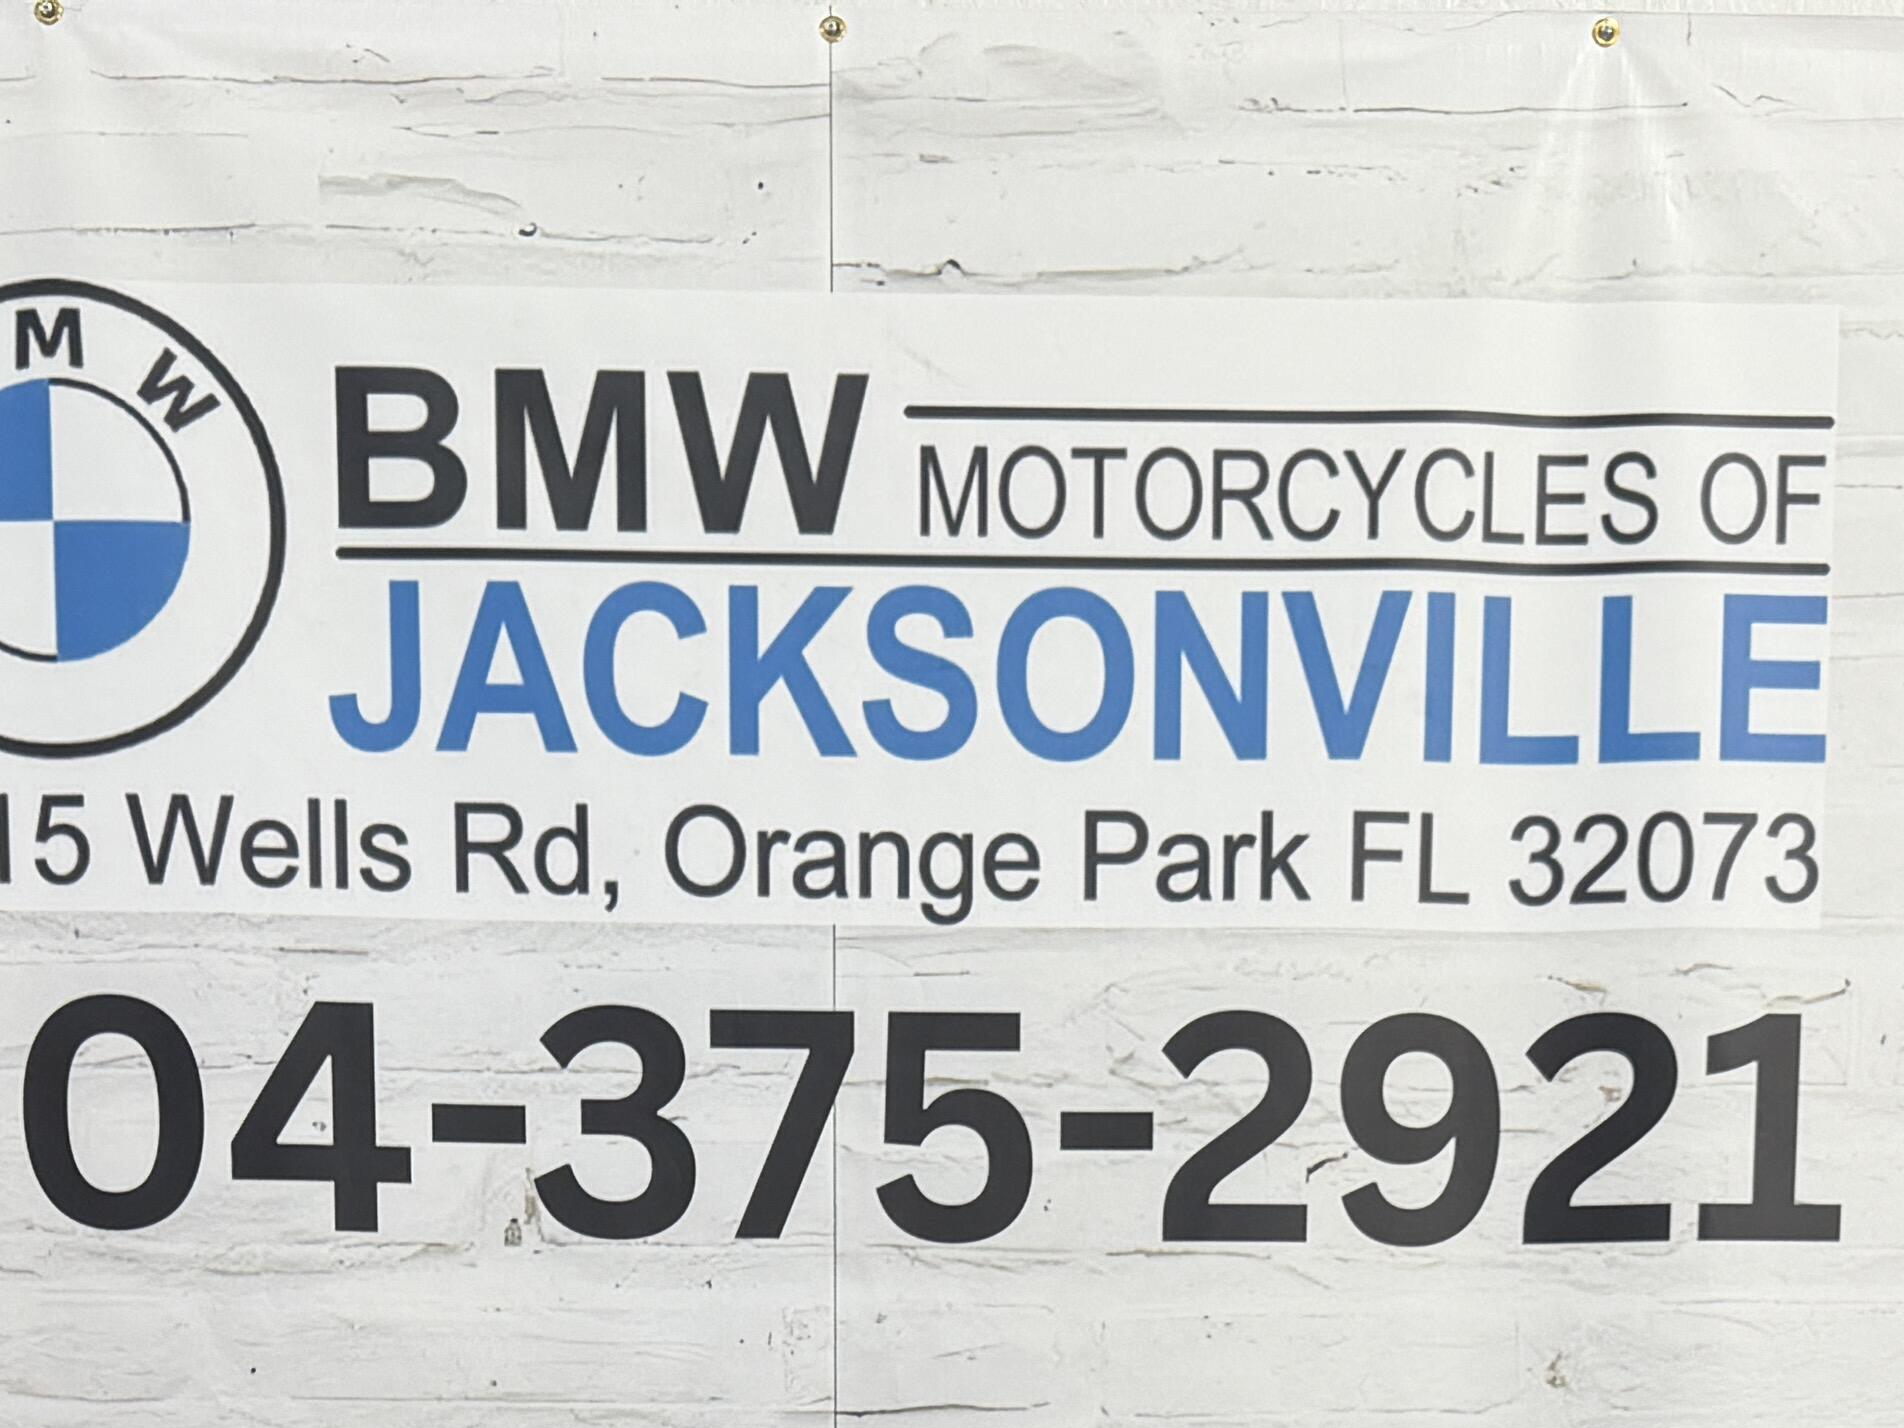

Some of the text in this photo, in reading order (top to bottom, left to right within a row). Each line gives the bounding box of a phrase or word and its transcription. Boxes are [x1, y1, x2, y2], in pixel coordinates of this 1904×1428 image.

[334, 365, 1827, 547] BMW MOTORCYCLES OF
[328, 579, 1829, 766] JACKSONVILLE
[125, 791, 414, 892] Wells
[454, 801, 620, 912] Rd,
[663, 803, 1042, 926] Orange
[1082, 808, 1313, 905] Park
[1350, 811, 1471, 907] FL
[1507, 811, 1822, 907] 32073
